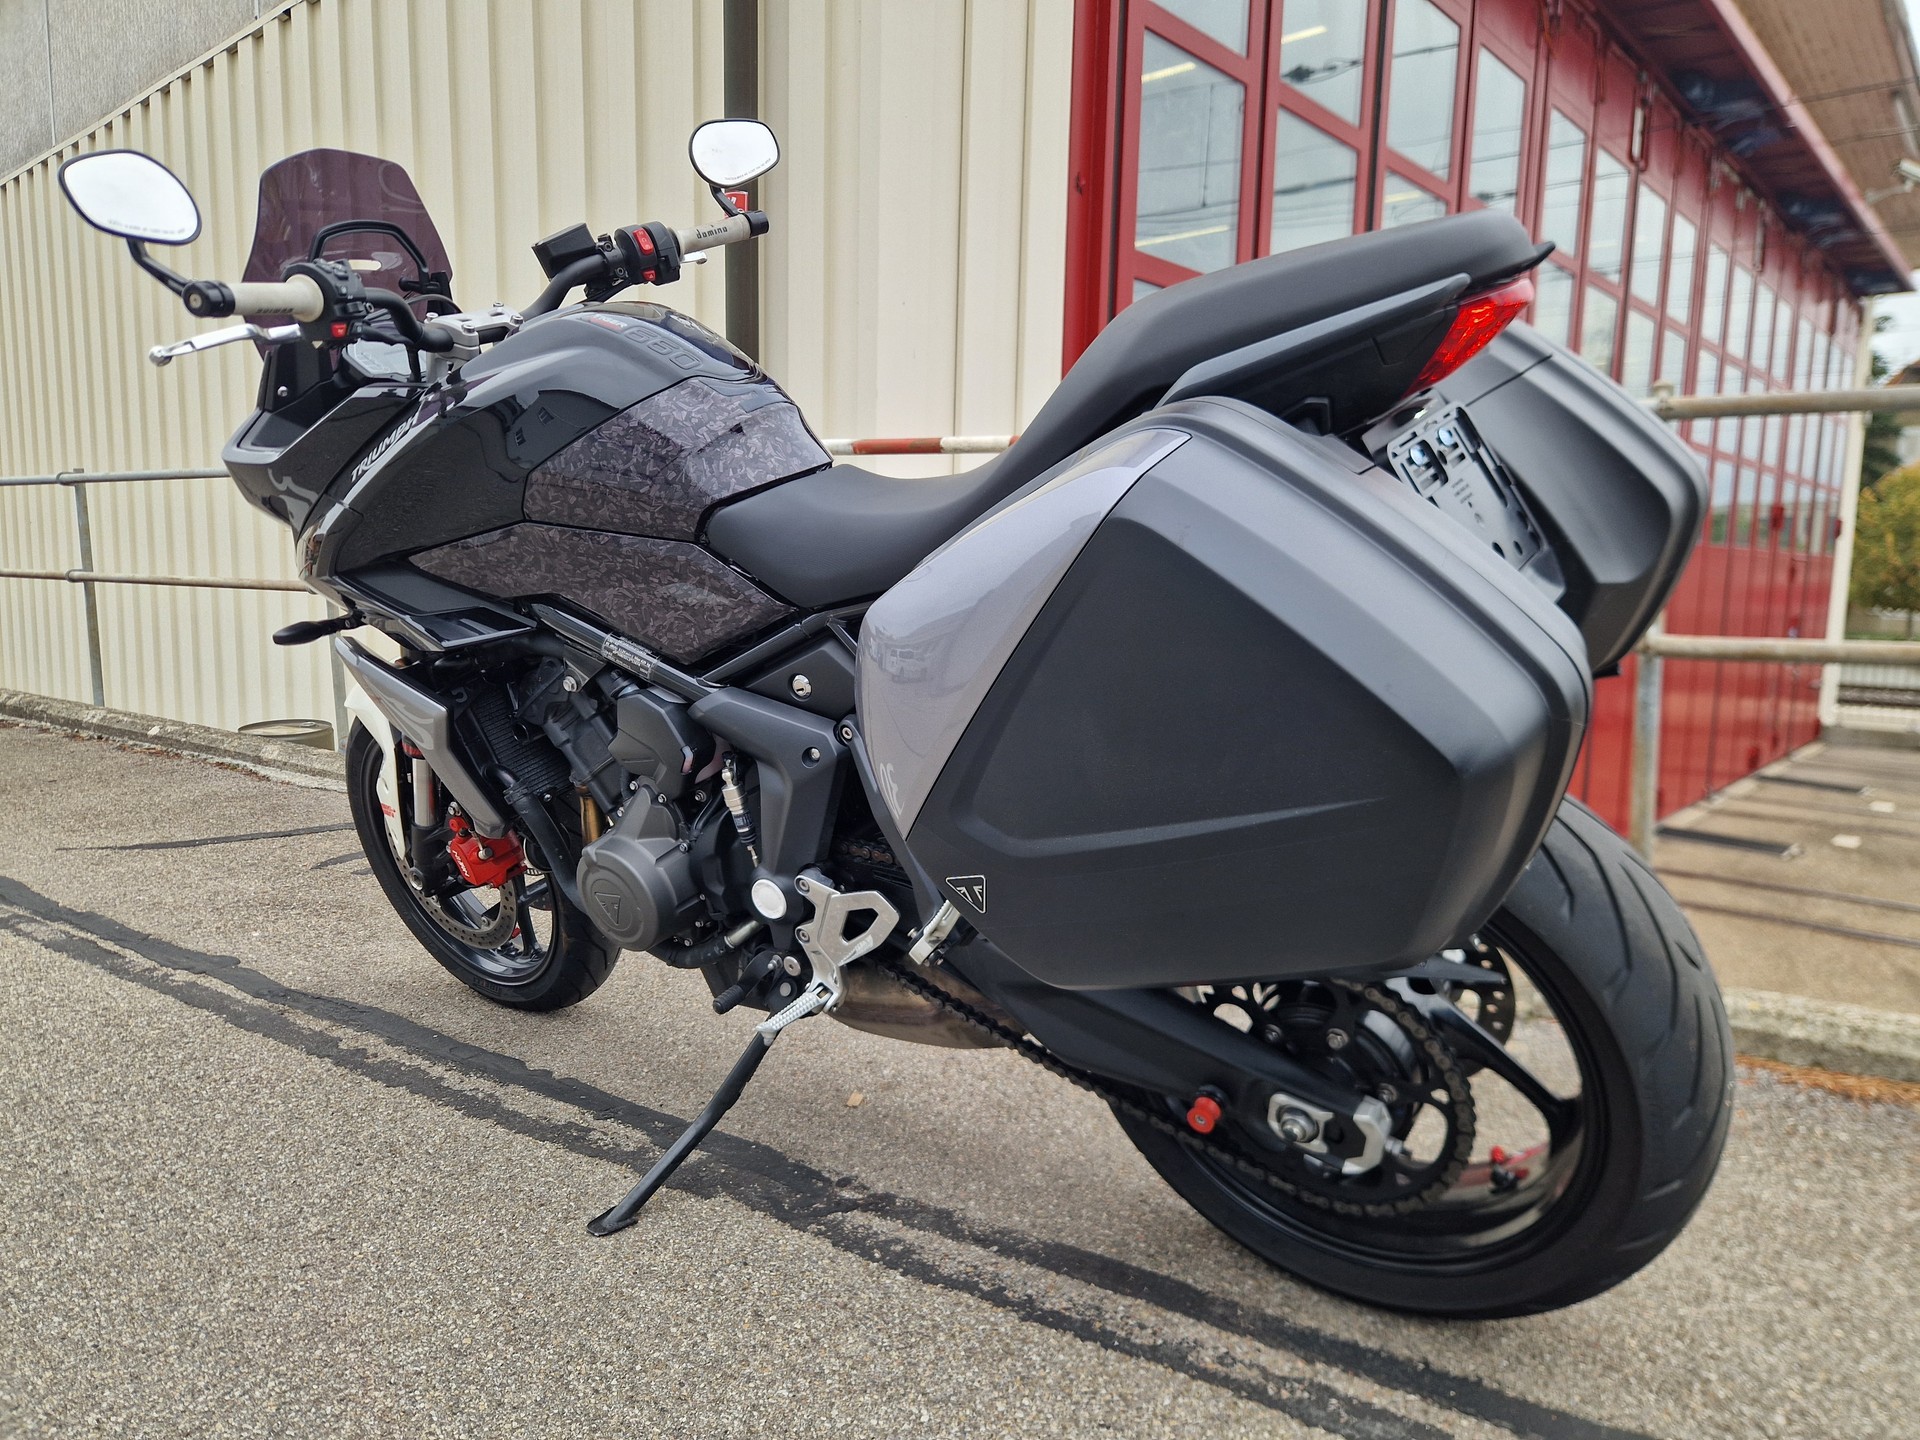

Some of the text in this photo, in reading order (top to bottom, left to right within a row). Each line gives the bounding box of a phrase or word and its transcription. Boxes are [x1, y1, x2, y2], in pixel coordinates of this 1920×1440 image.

[696, 224, 728, 239] domino
[624, 325, 703, 371] 660
[351, 411, 419, 483] TRIUMPH
